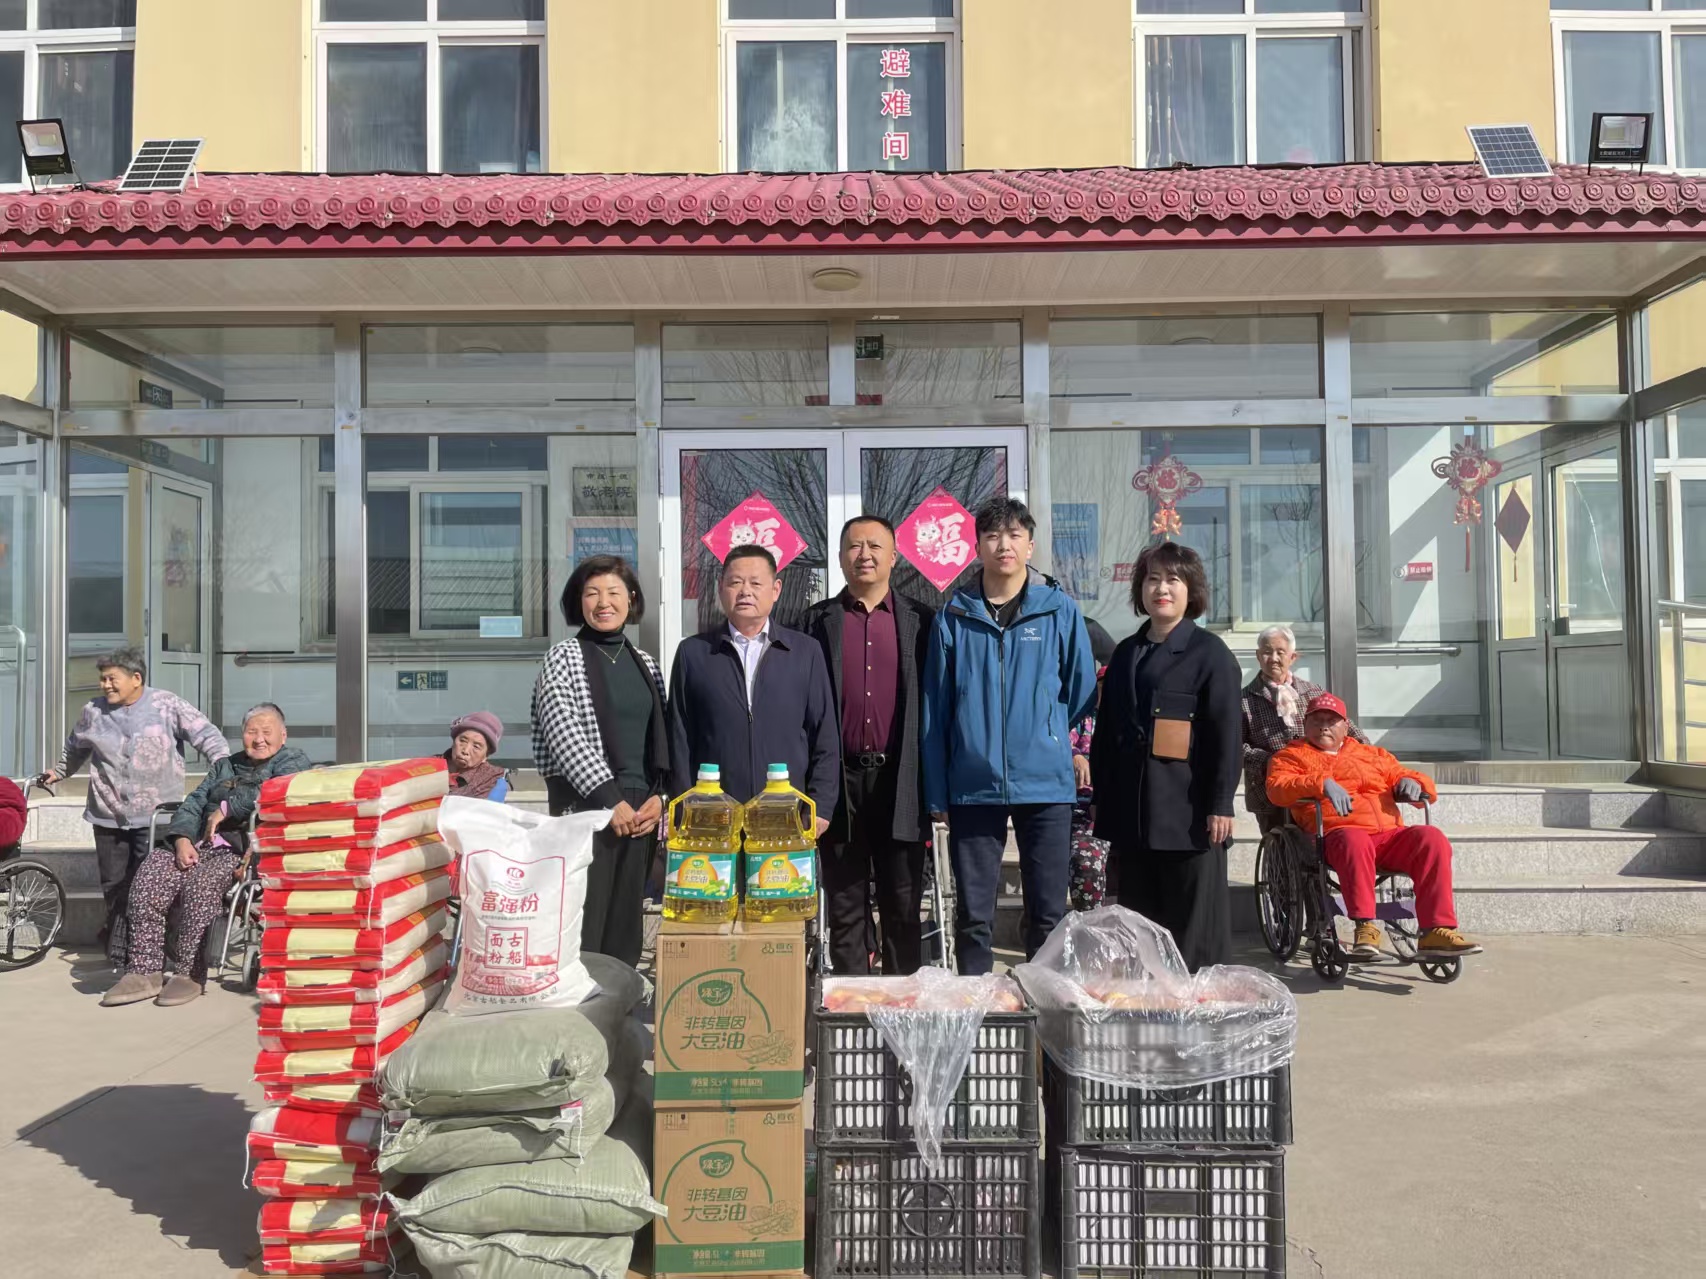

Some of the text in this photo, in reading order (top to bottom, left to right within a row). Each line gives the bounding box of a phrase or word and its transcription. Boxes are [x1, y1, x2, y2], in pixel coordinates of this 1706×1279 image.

[880, 49, 911, 160] 避难间
[582, 486, 633, 498] 敬老院
[481, 890, 540, 914] 富强粉
[685, 1016, 747, 1030] 非转基因
[680, 1031, 746, 1050] 大豆油
[687, 1187, 749, 1201] 非转基因
[681, 1203, 748, 1222] 大豆油
